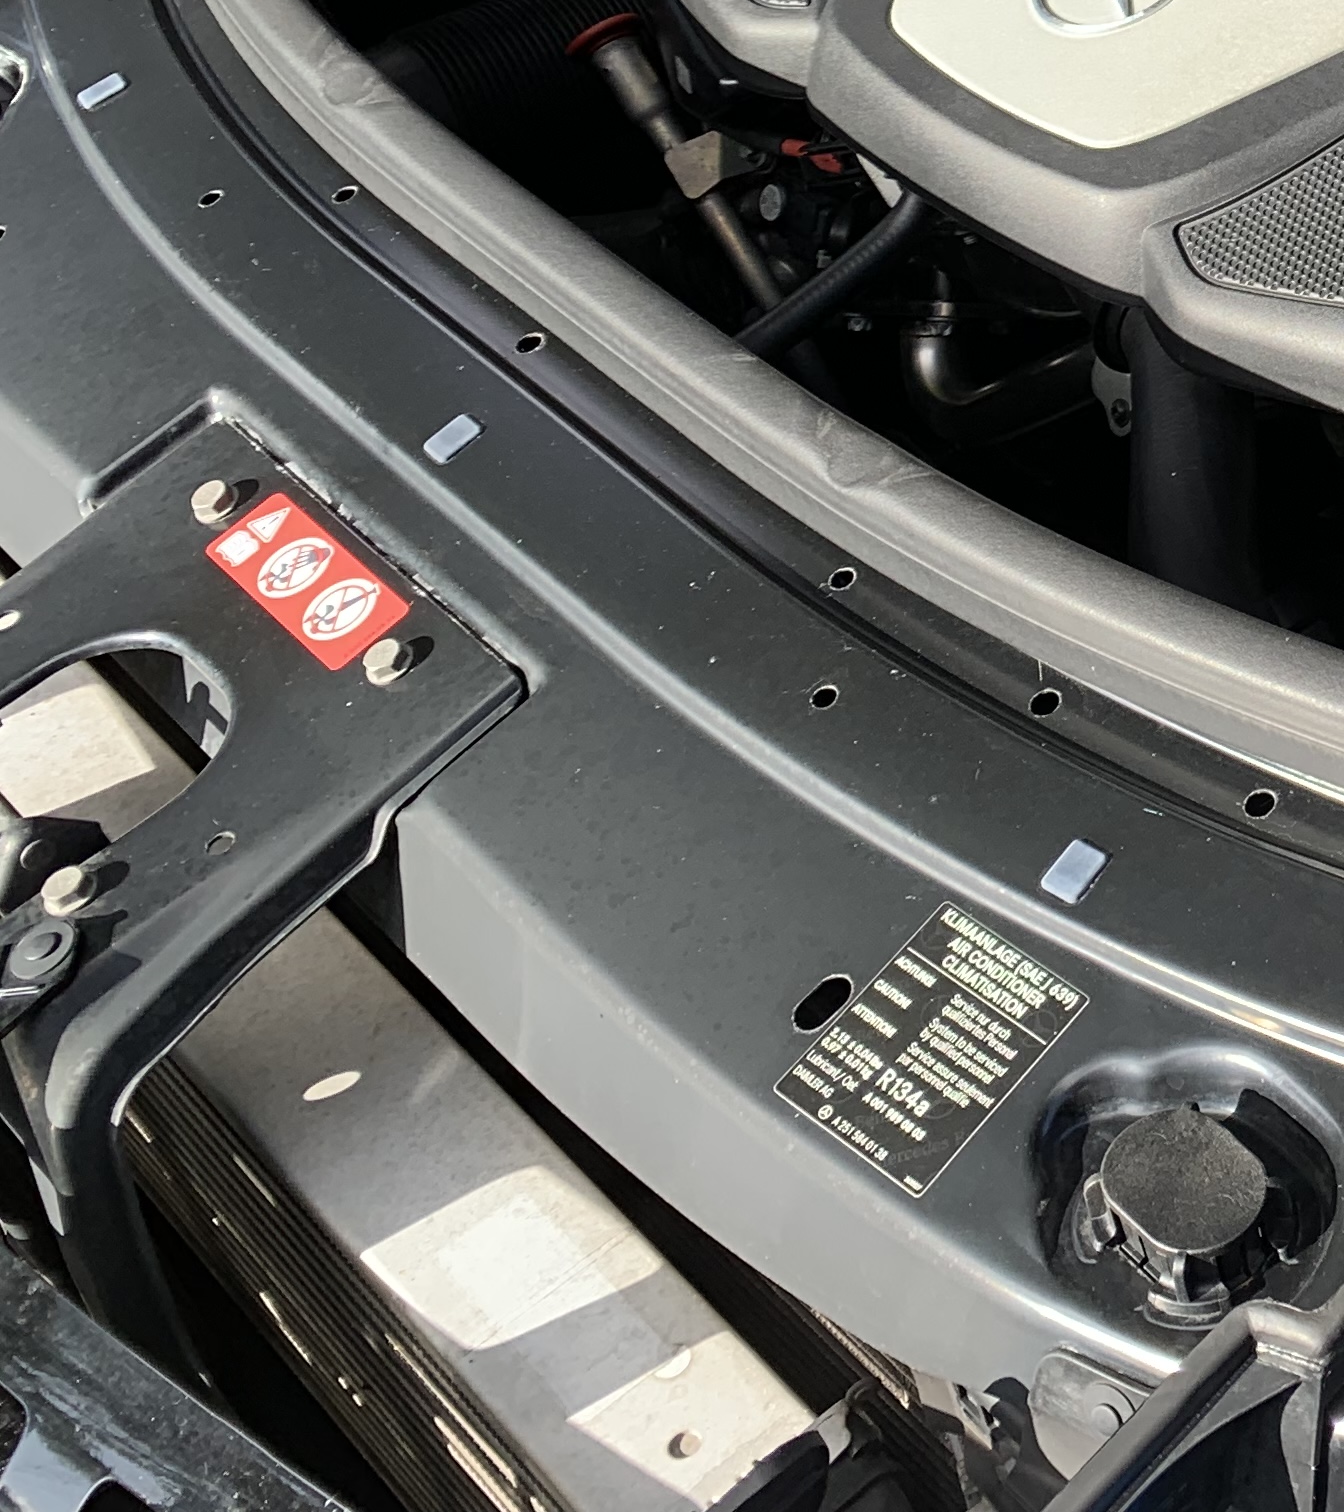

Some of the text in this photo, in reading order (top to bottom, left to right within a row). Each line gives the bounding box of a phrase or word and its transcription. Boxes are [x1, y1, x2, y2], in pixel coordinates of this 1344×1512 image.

[938, 905, 1022, 969] KLIMAANLAGE
[1011, 958, 1048, 989] (SAE
[1043, 979, 1082, 1012] 639)
[945, 934, 1047, 1010] AIR CONDITIONER
[871, 976, 914, 1010] CAUTION!
[939, 951, 1029, 1020] CLIMATISATION
[849, 1000, 899, 1040] ATTENTION!
[948, 991, 1014, 1041] Service nur durch
[904, 1039, 938, 1068] Service
[916, 1026, 996, 1087] by qualified personnel
[925, 1015, 961, 1046] System
[962, 1041, 979, 1057] be
[972, 1046, 1010, 1078] serviced
[982, 1031, 1018, 1061] Personal
[817, 1082, 835, 1099] AG
[873, 1066, 935, 1118] R134a
[894, 1052, 913, 1069] par
[906, 1059, 948, 1094] personnel
[836, 1118, 857, 1137] 251
